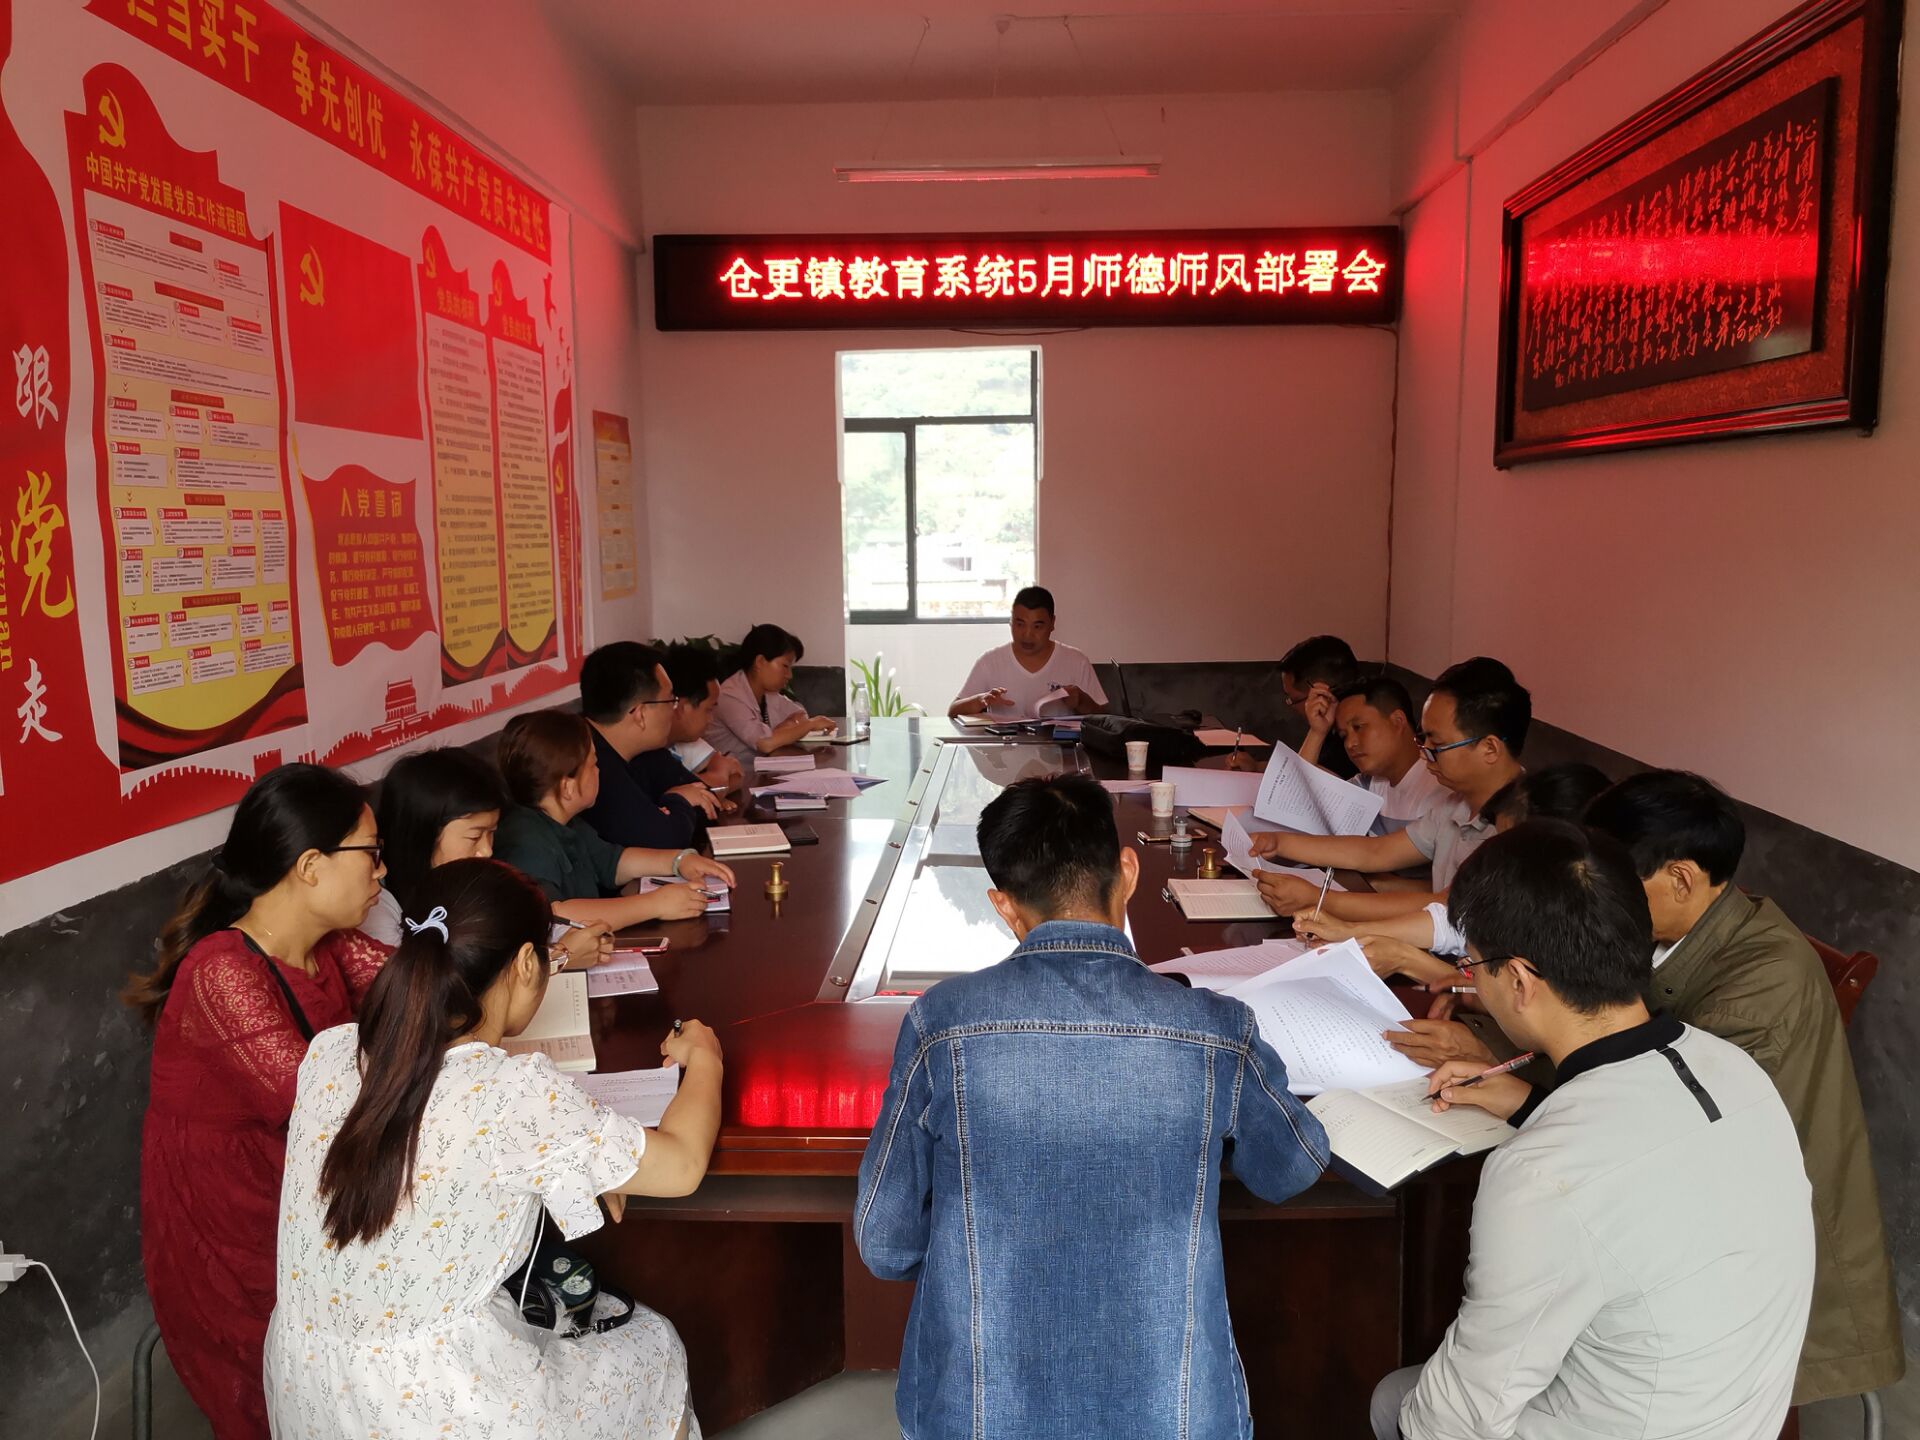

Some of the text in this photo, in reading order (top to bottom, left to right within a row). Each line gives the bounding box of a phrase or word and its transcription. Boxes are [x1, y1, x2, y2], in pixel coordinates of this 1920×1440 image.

[291, 40, 386, 160] 争先创优
[410, 118, 547, 252] 永葆共产党员先进性
[86, 151, 247, 239] 中国共产党发展党员工作流程图
[720, 249, 1386, 300] 仓更镇教育系统5月师德师风部署会
